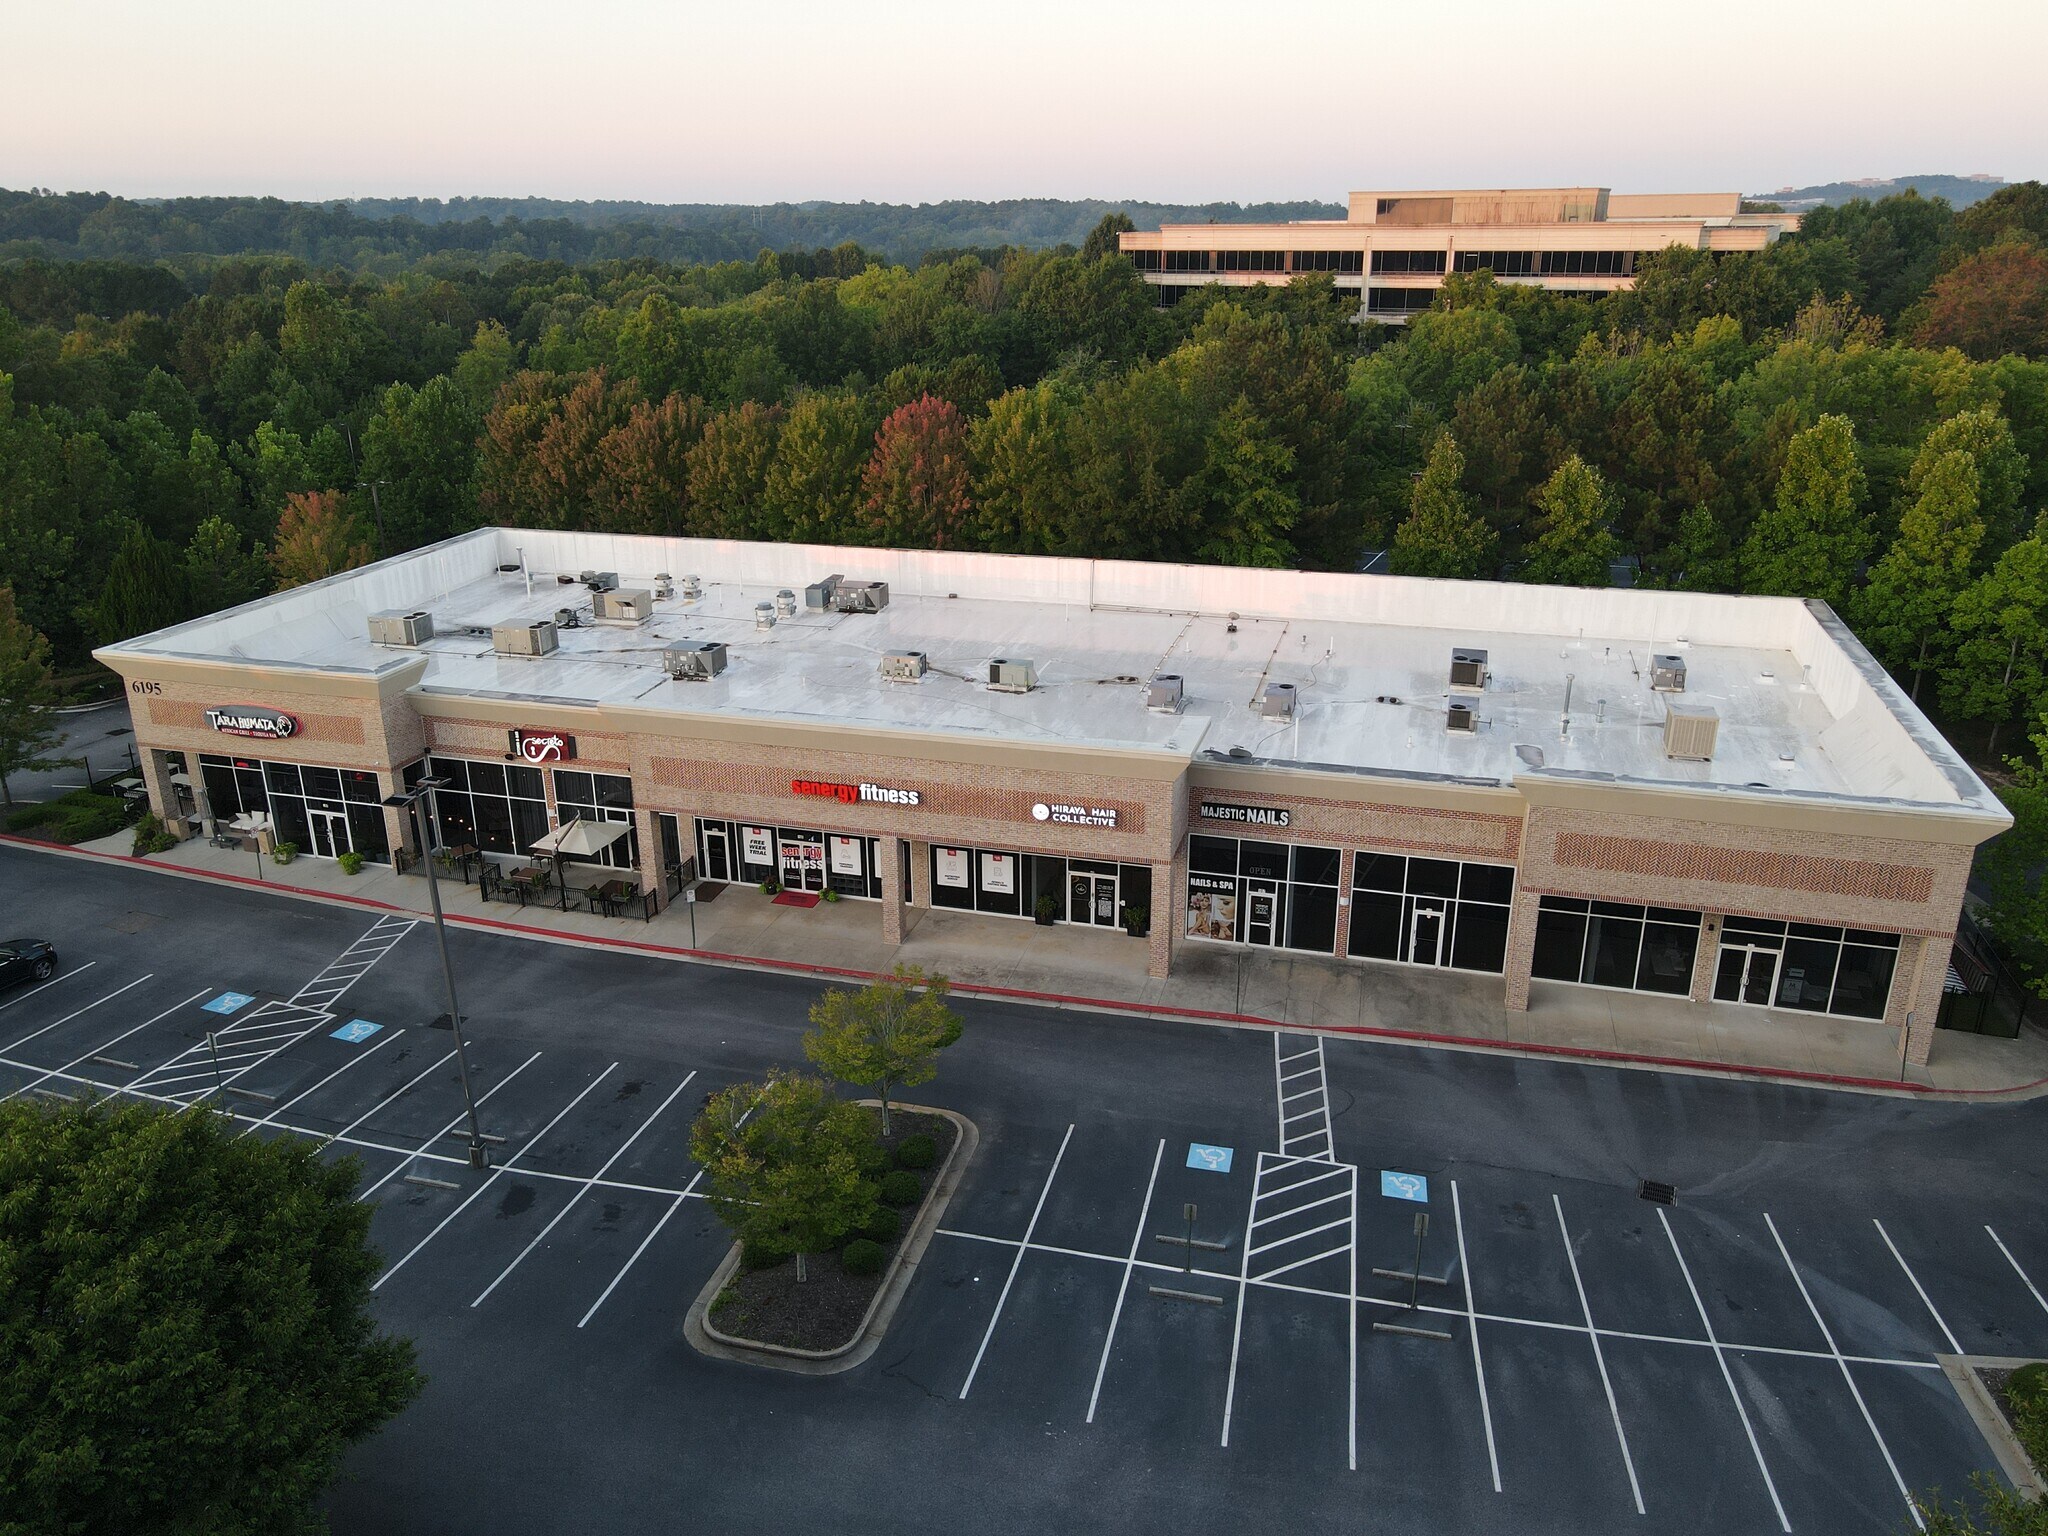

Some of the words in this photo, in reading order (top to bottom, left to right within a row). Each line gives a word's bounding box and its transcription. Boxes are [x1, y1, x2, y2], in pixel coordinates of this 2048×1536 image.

[132, 680, 162, 695] 6195
[792, 780, 858, 805] senergy
[859, 783, 919, 805] fitness
[1051, 804, 1086, 815] HIRAYA
[1091, 808, 1116, 818] HAIR
[1201, 806, 1245, 820] MAJESTIC
[1246, 808, 1289, 826] NAILS
[1052, 813, 1116, 827] COLLECTIVE
[1249, 866, 1272, 876] OPEN
[1190, 877, 1211, 888] NAILS
[1219, 880, 1234, 890] SPA
